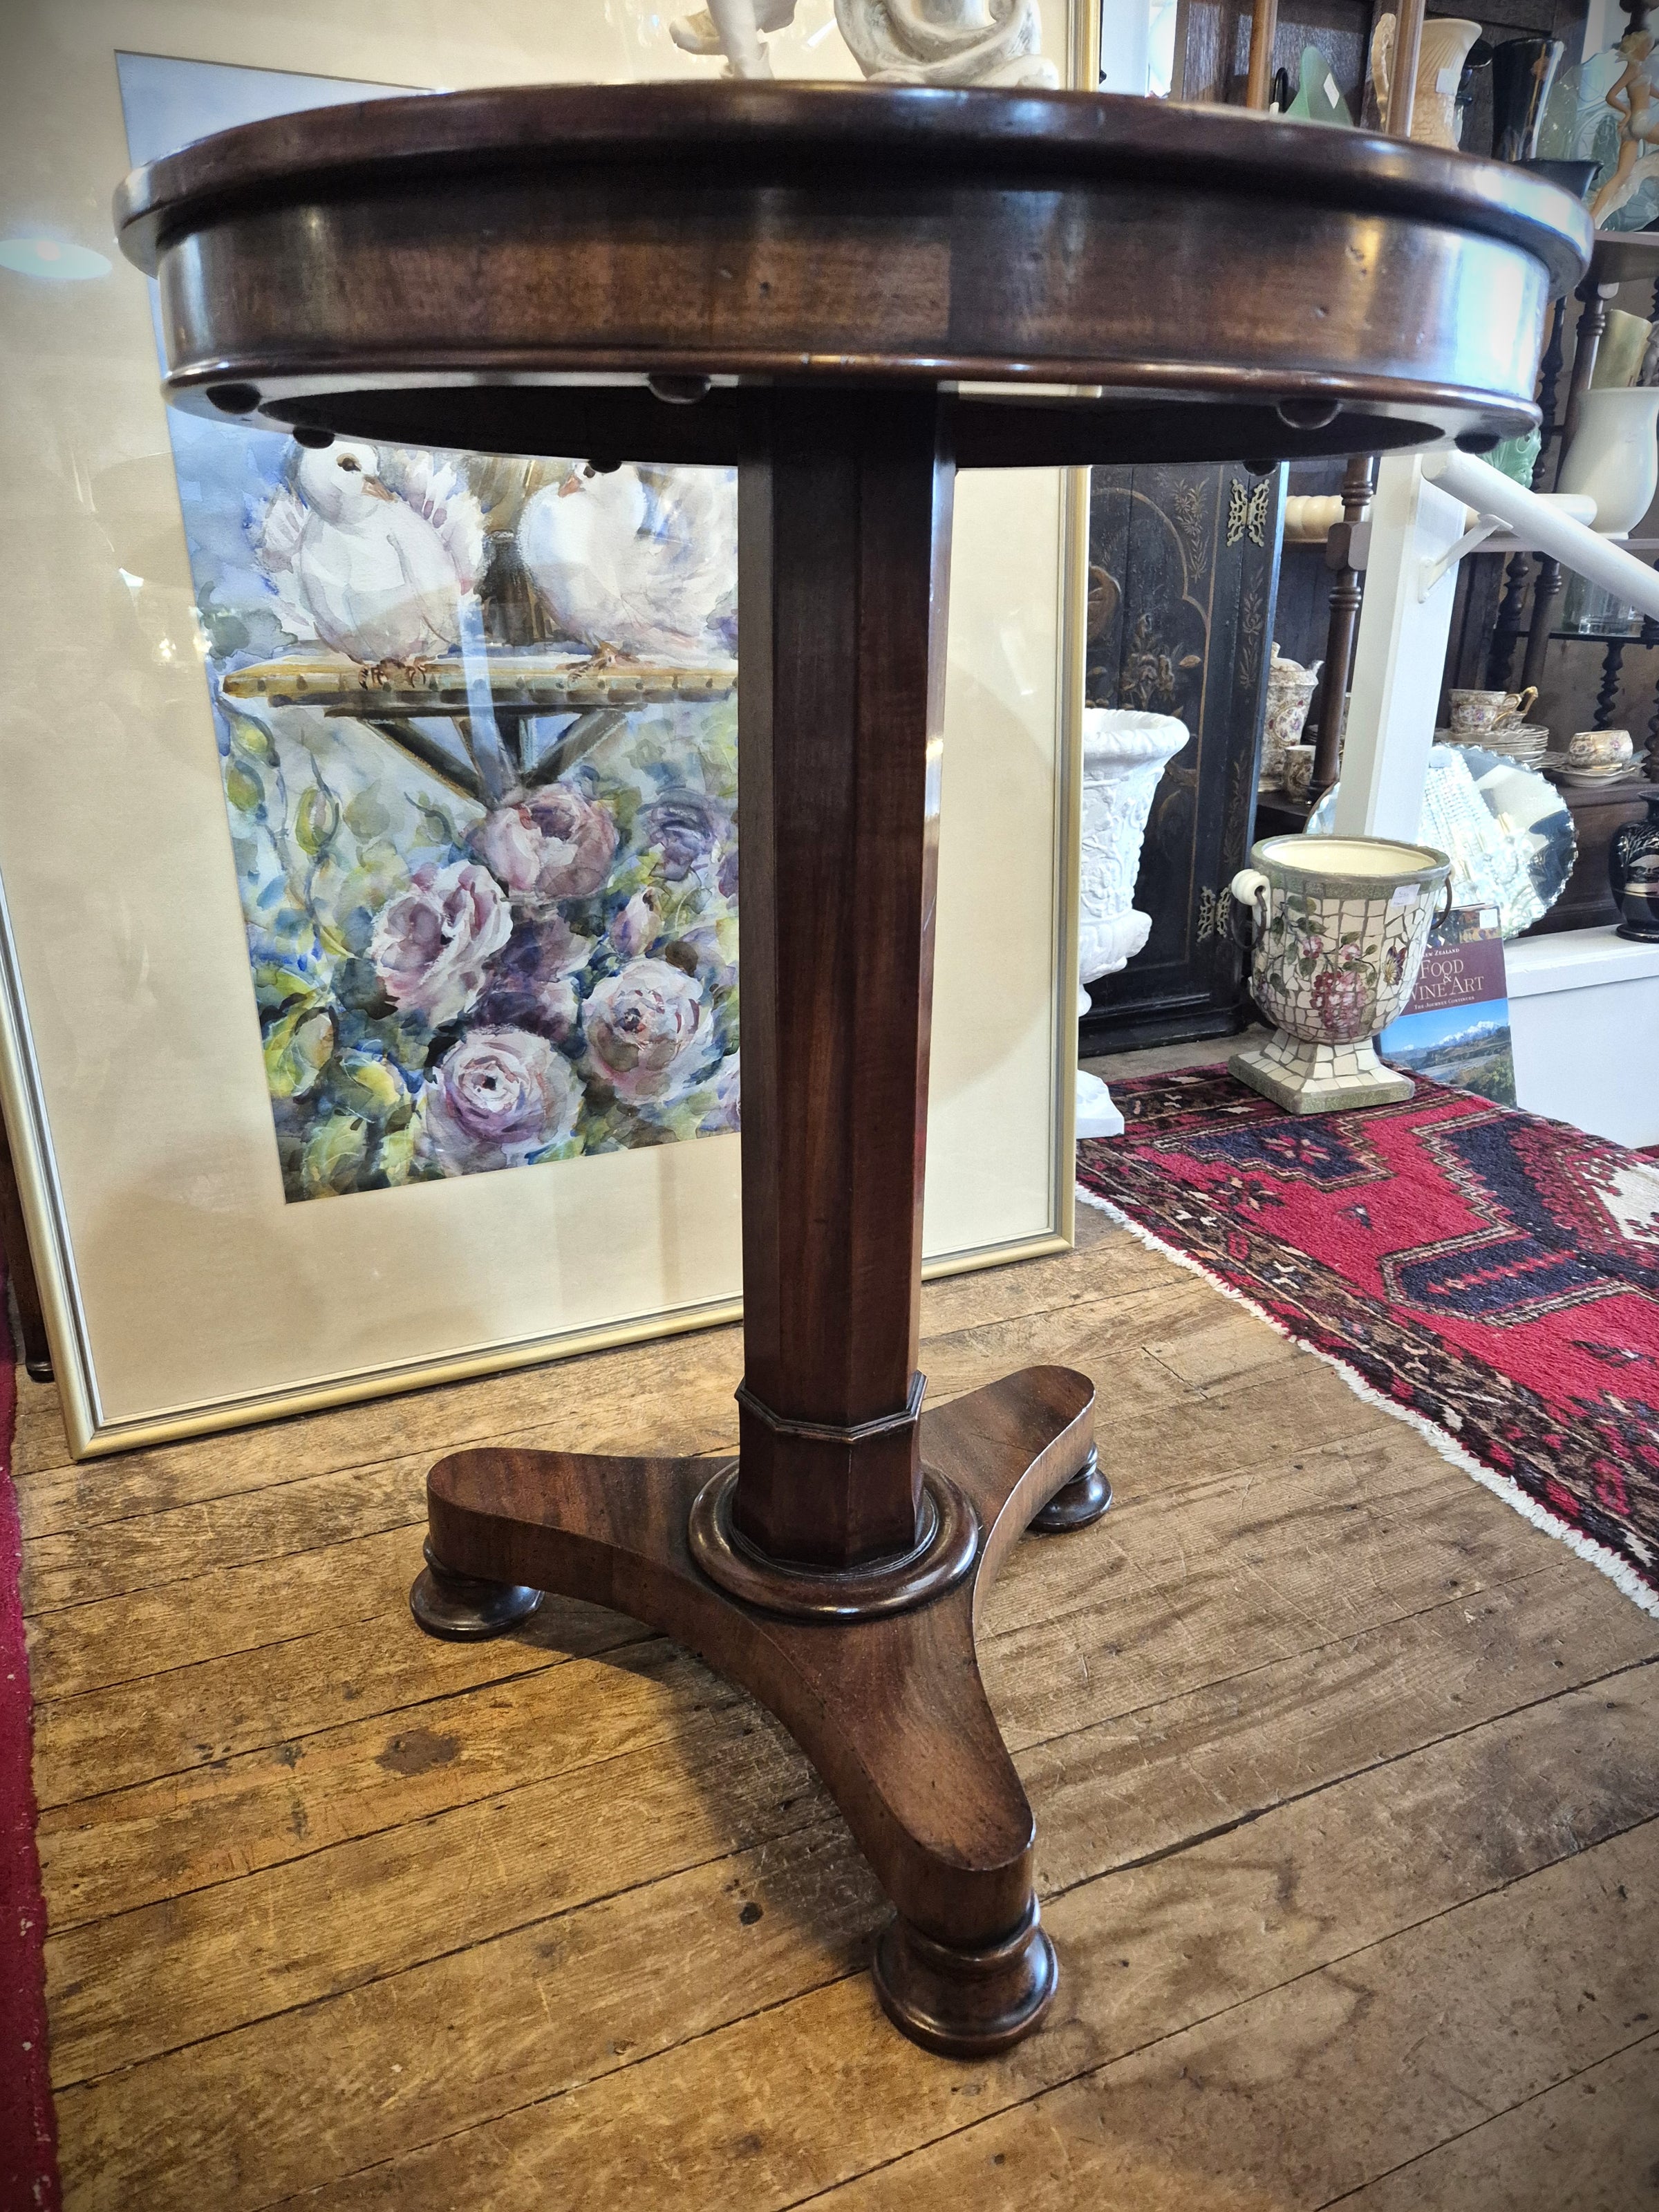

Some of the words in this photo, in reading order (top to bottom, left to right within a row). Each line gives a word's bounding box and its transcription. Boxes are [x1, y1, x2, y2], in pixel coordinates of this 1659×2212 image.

[1434, 947, 1460, 956] ZEALAND
[1420, 959, 1464, 980] FOOD
[1443, 973, 1452, 983] &
[1449, 976, 1484, 995] ART
